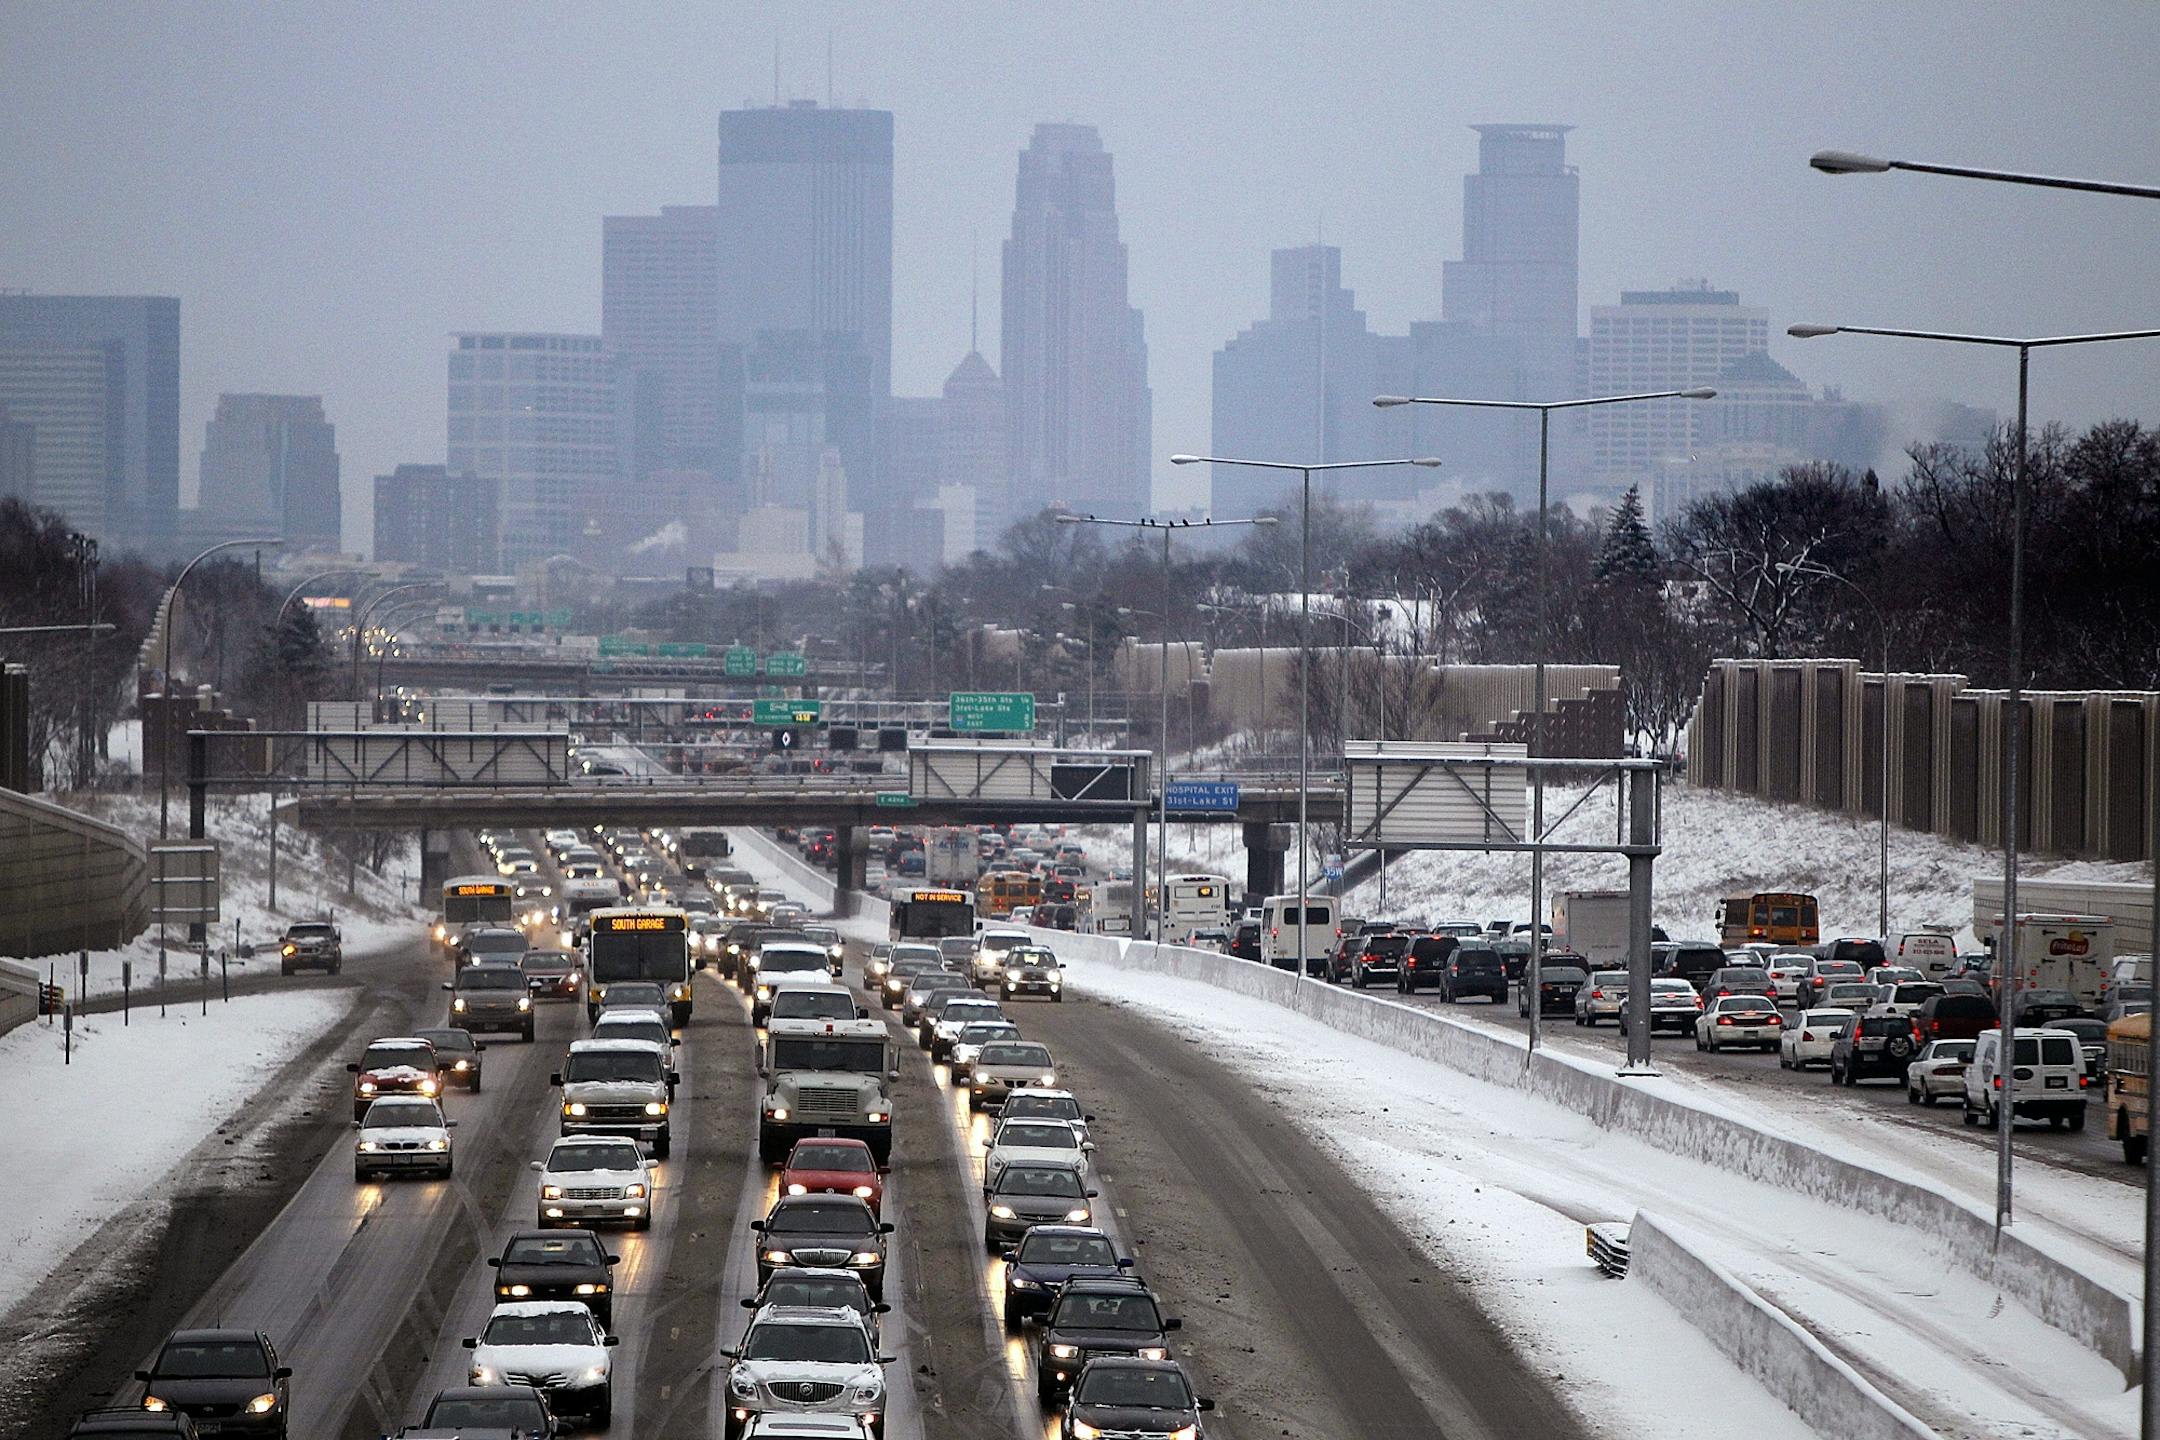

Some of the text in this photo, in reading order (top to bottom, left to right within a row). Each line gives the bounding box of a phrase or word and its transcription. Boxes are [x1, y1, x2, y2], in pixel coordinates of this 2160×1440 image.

[1166, 786, 1234, 794] HOSPITAL EXIT
[1167, 796, 1233, 805] 31st-Lake St
[459, 885, 496, 896] SOUTH GARAGE
[915, 893, 962, 902] NOT IN SERVICE
[612, 918, 665, 930] SOUTH GARAGE
